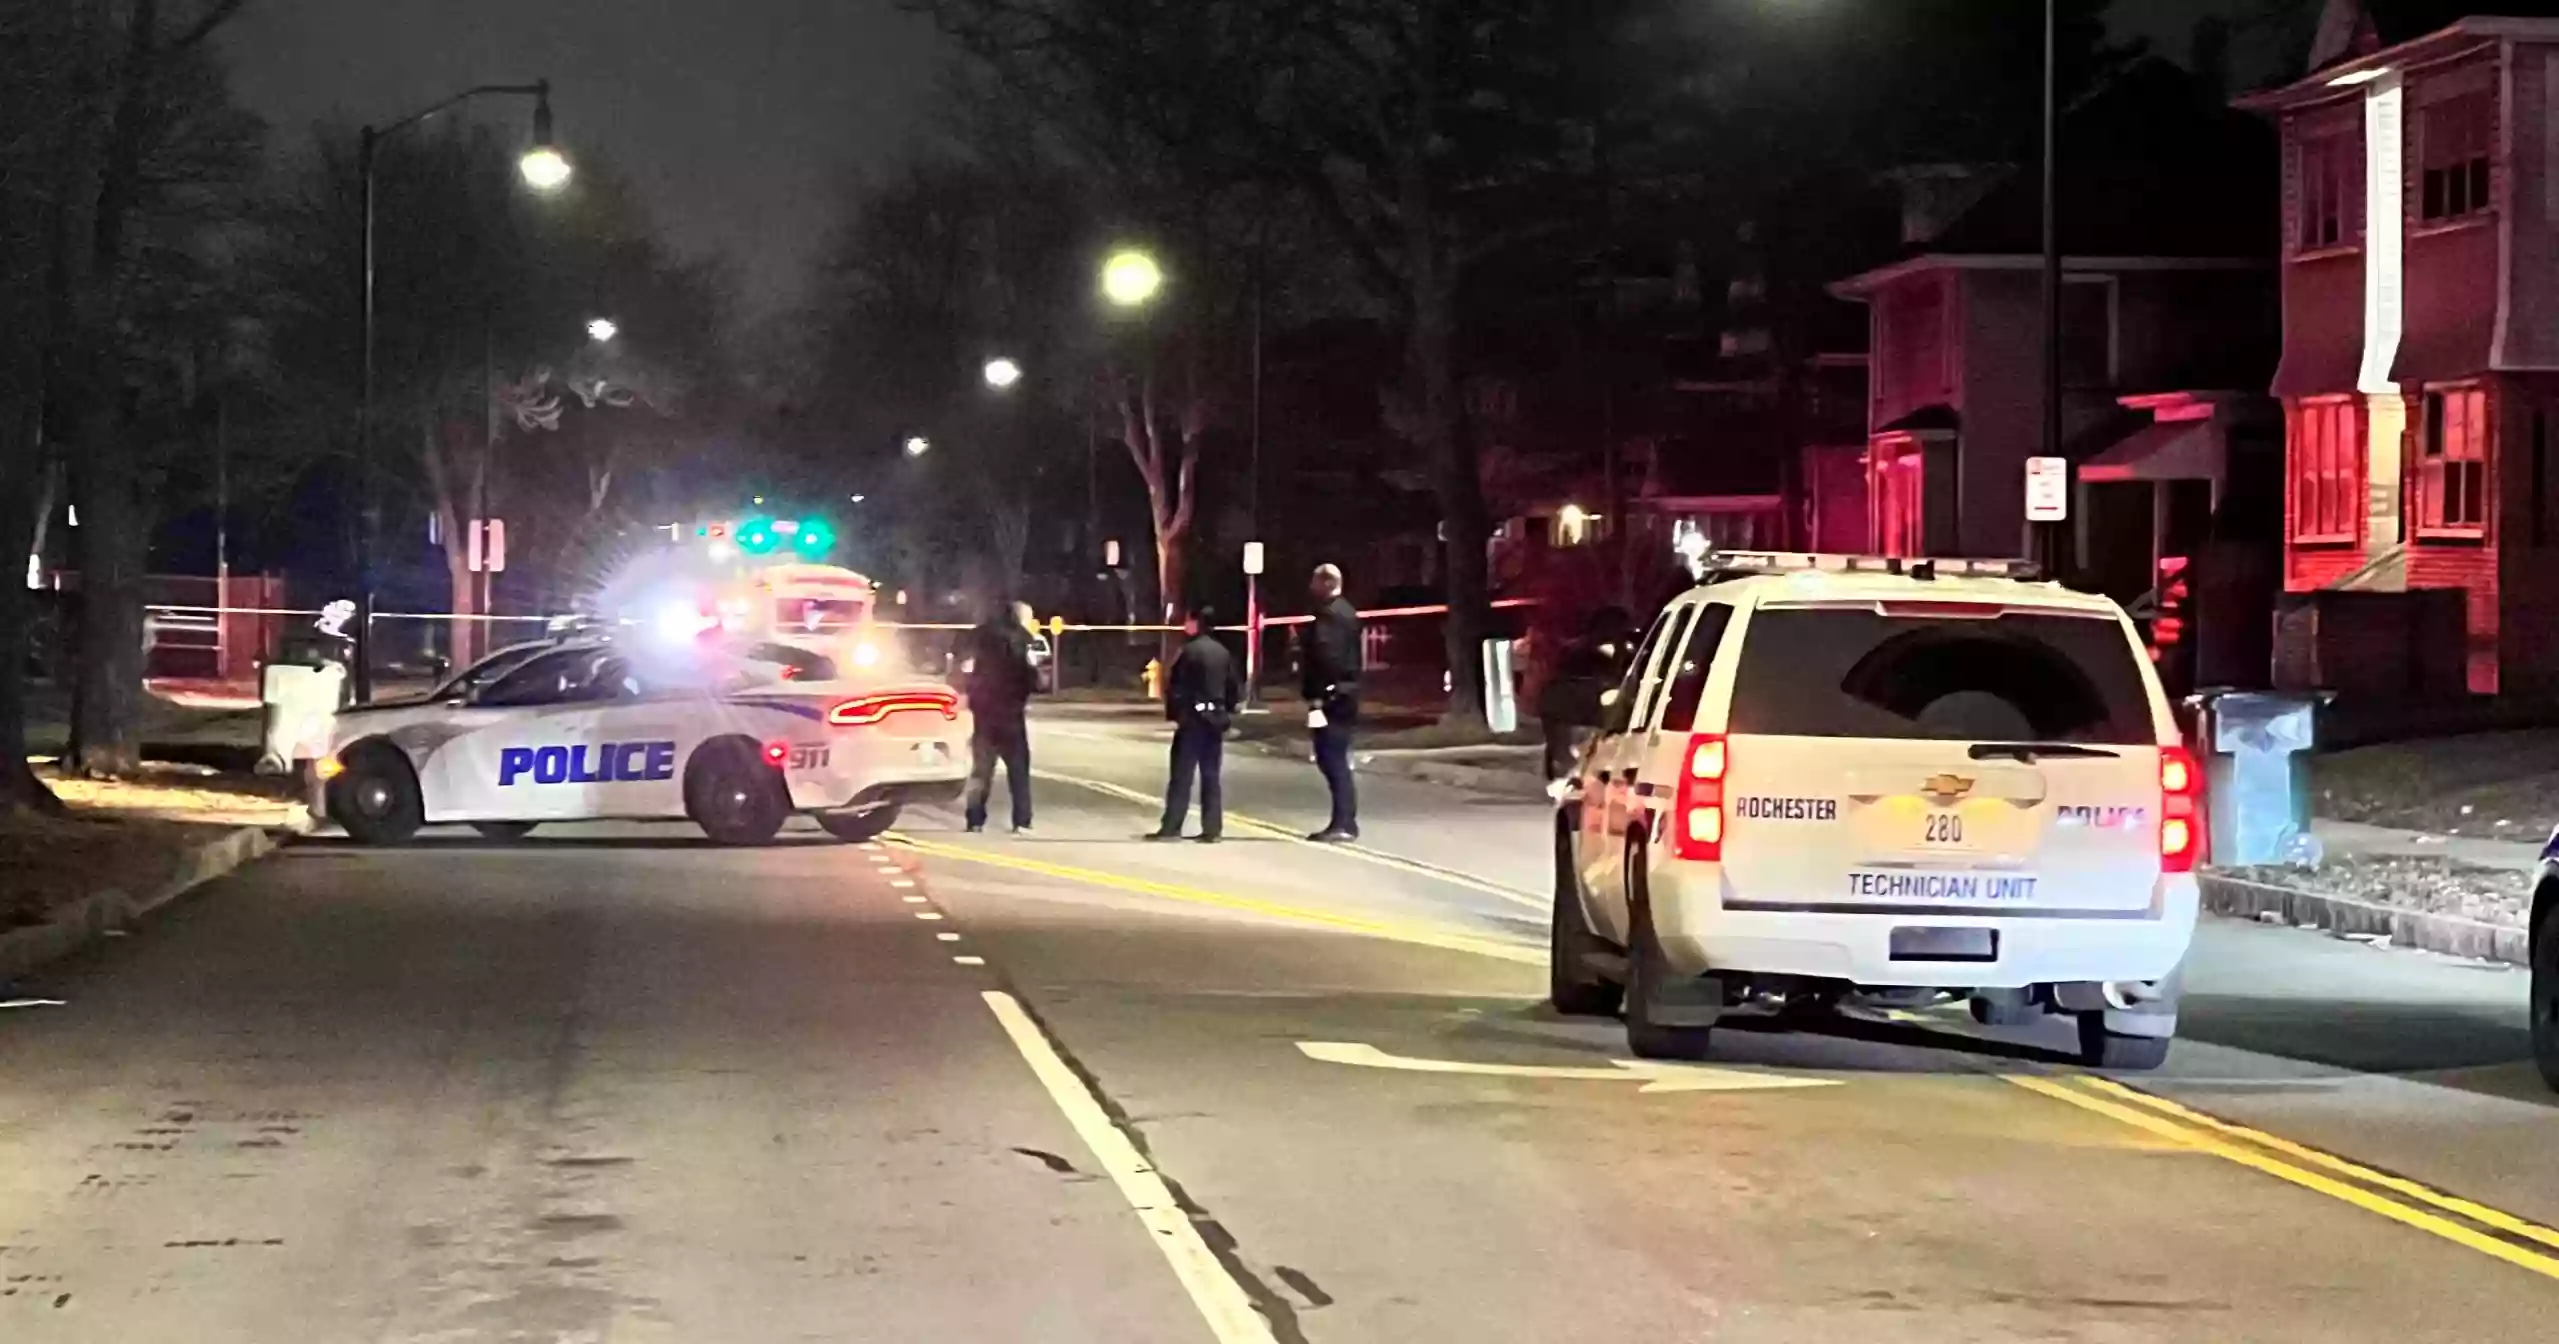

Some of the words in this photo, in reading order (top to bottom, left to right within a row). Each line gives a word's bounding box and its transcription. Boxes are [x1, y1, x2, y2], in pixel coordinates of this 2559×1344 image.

[499, 742, 677, 786] POLICE
[790, 748, 830, 769] 911
[1736, 797, 1836, 820] ROCHESTER
[1925, 814, 1962, 842] 280
[1848, 873, 1978, 898] TECHNICIAN
[1986, 877, 2038, 899] UNIT
